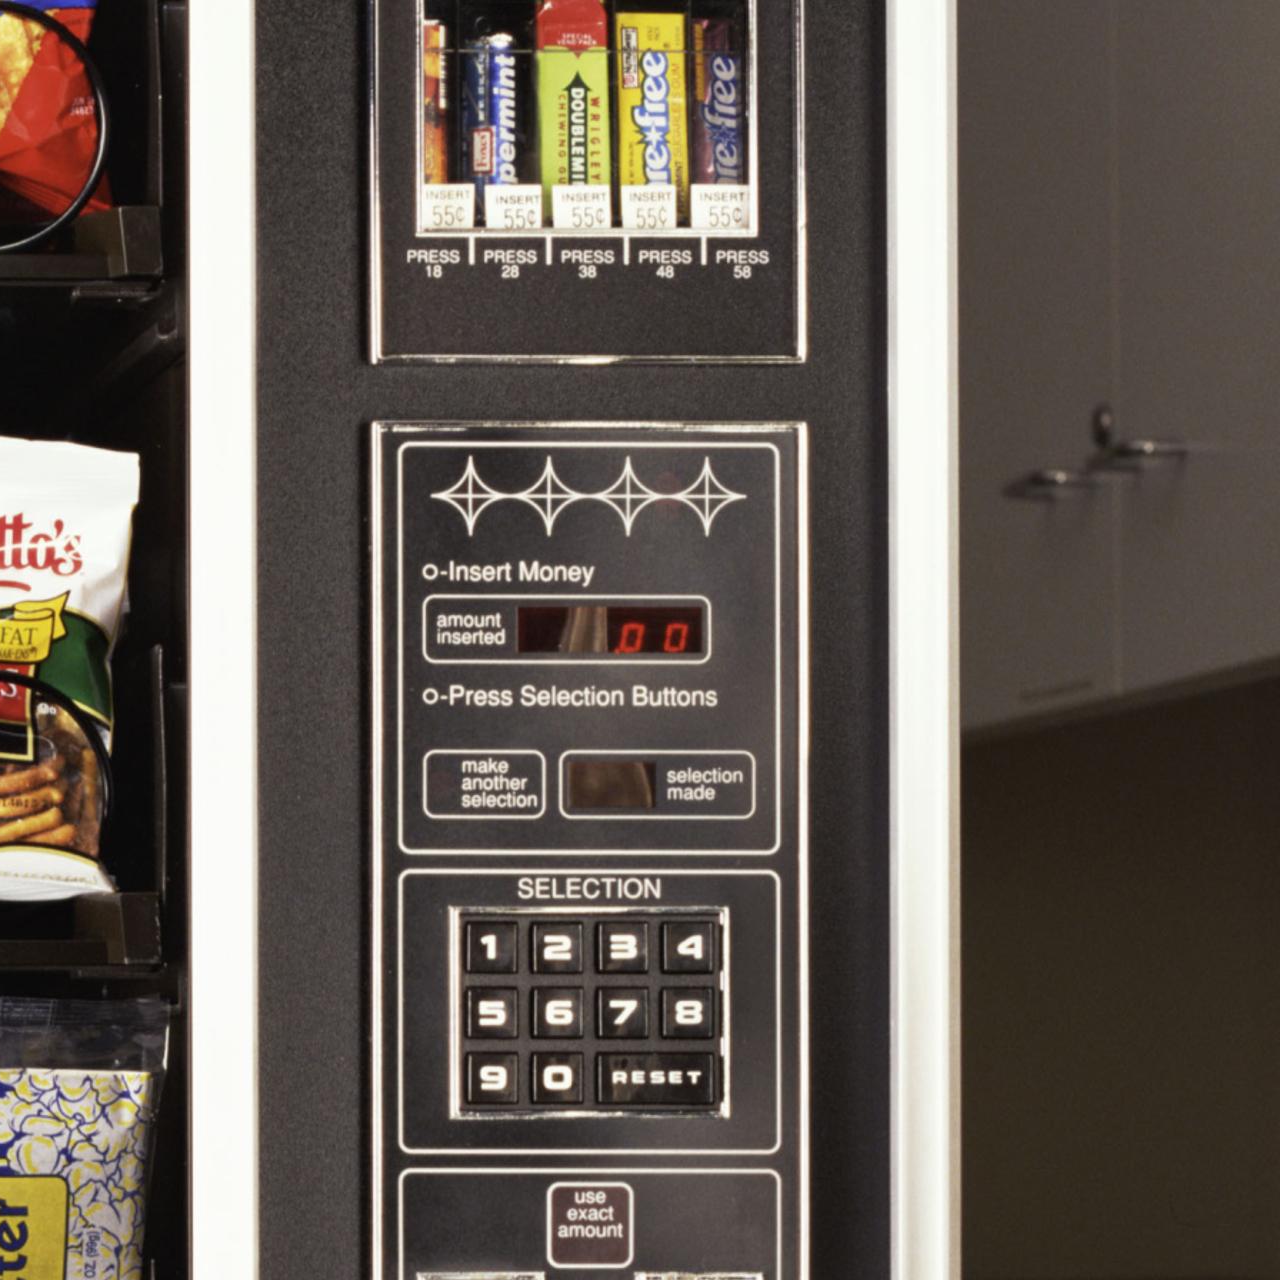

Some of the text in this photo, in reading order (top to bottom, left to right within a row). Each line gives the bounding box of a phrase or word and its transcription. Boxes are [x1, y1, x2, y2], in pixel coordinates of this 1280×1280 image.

[406, 250, 460, 264] PRESS
[561, 250, 615, 264] PRESS
[716, 250, 769, 264] PRESS
[426, 266, 441, 278] 18
[579, 266, 597, 278] 38
[733, 266, 751, 278] 58
[519, 561, 595, 586] Money
[437, 614, 501, 627] amount
[0, 624, 37, 645] FAT
[437, 629, 505, 644] inserted
[520, 686, 624, 706] Selection
[632, 686, 717, 706] Buttons
[462, 759, 508, 773] make
[462, 776, 526, 790] another
[667, 768, 742, 783] selection
[462, 793, 537, 807] selection
[667, 786, 715, 800] made
[517, 879, 661, 899] SELECTION
[480, 935, 496, 959] 1
[543, 935, 571, 959] 2
[610, 935, 637, 959] 3
[677, 935, 703, 959] 4
[479, 1001, 505, 1025] 5
[545, 1001, 573, 1025] 6
[609, 1001, 637, 1025] 7
[675, 1001, 702, 1025] 8
[480, 1065, 507, 1090] 9
[612, 1071, 701, 1084] RESET
[574, 1191, 606, 1204] use
[567, 1206, 613, 1221] exact
[558, 1223, 622, 1238] amount
